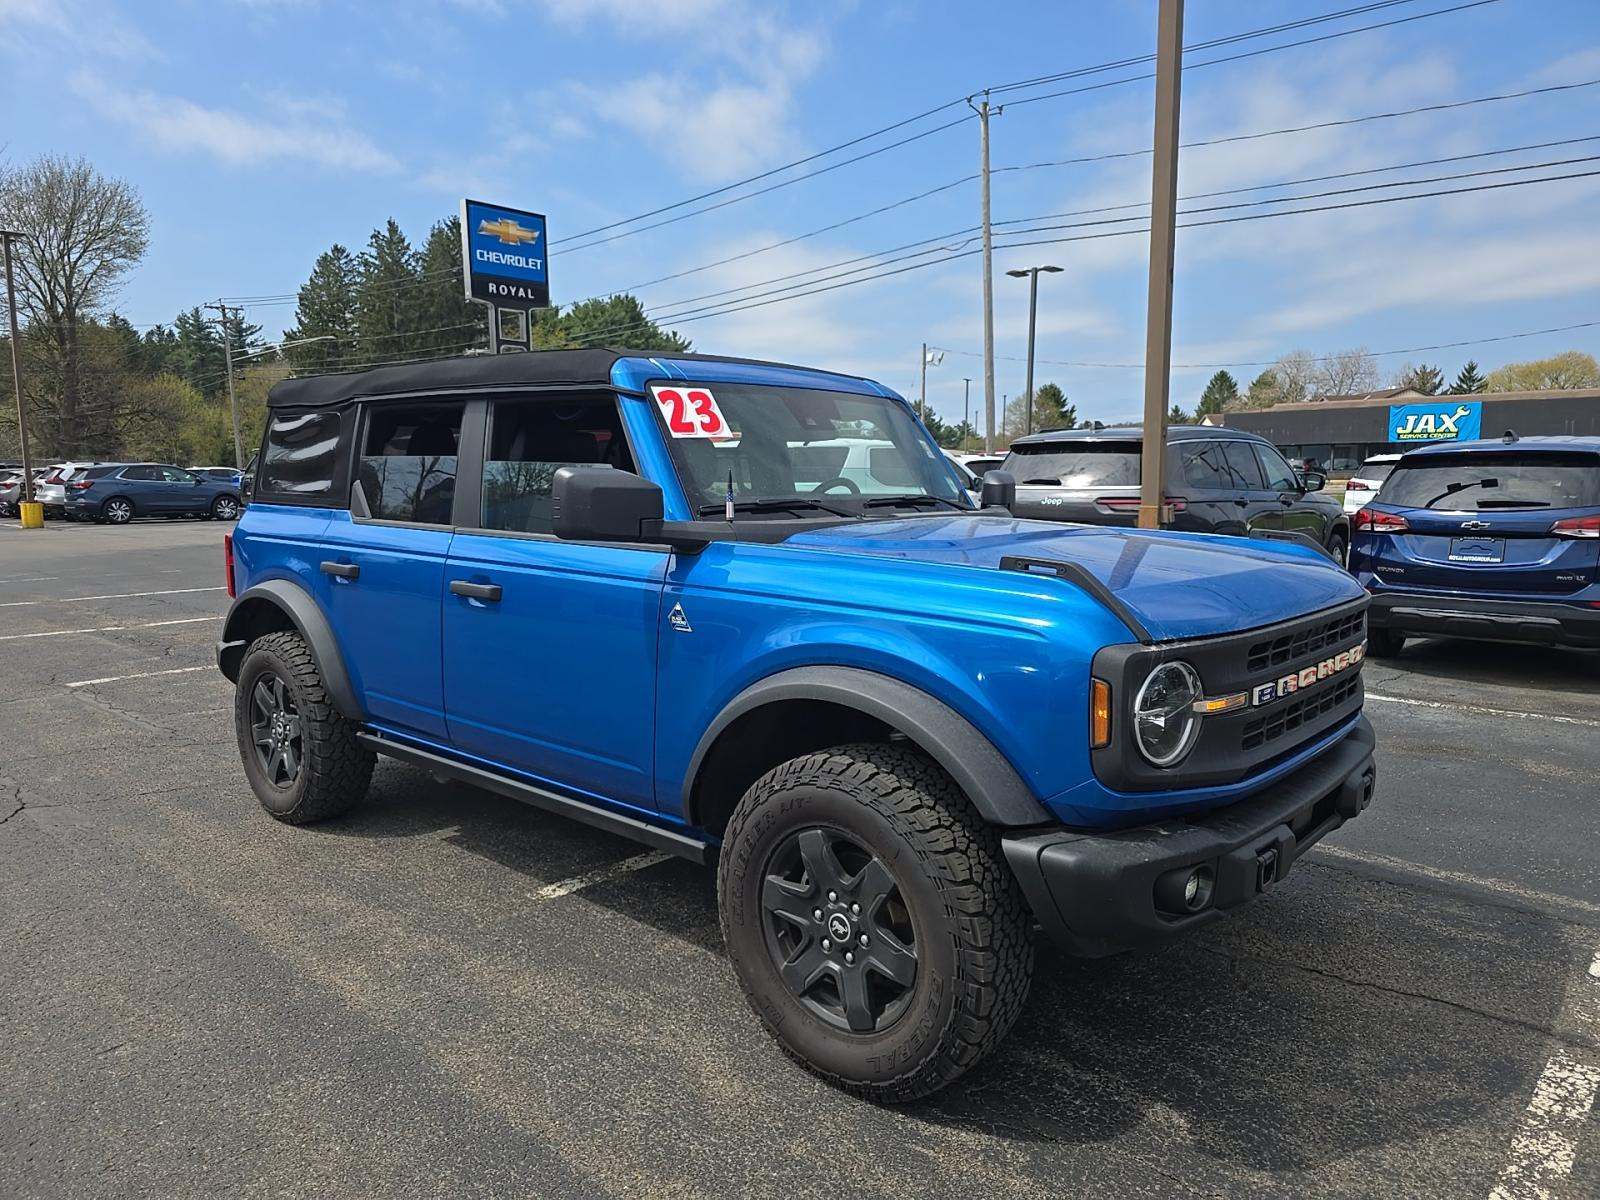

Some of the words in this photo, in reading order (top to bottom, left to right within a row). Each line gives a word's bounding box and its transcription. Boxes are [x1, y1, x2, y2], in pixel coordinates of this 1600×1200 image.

[476, 249, 542, 270] CHEVROLET
[488, 282, 535, 299] ROYAL
[657, 389, 721, 433] 23
[1396, 409, 1466, 433] JAX
[1040, 496, 1063, 506] Jeep
[1252, 645, 1366, 705] BRONCO
